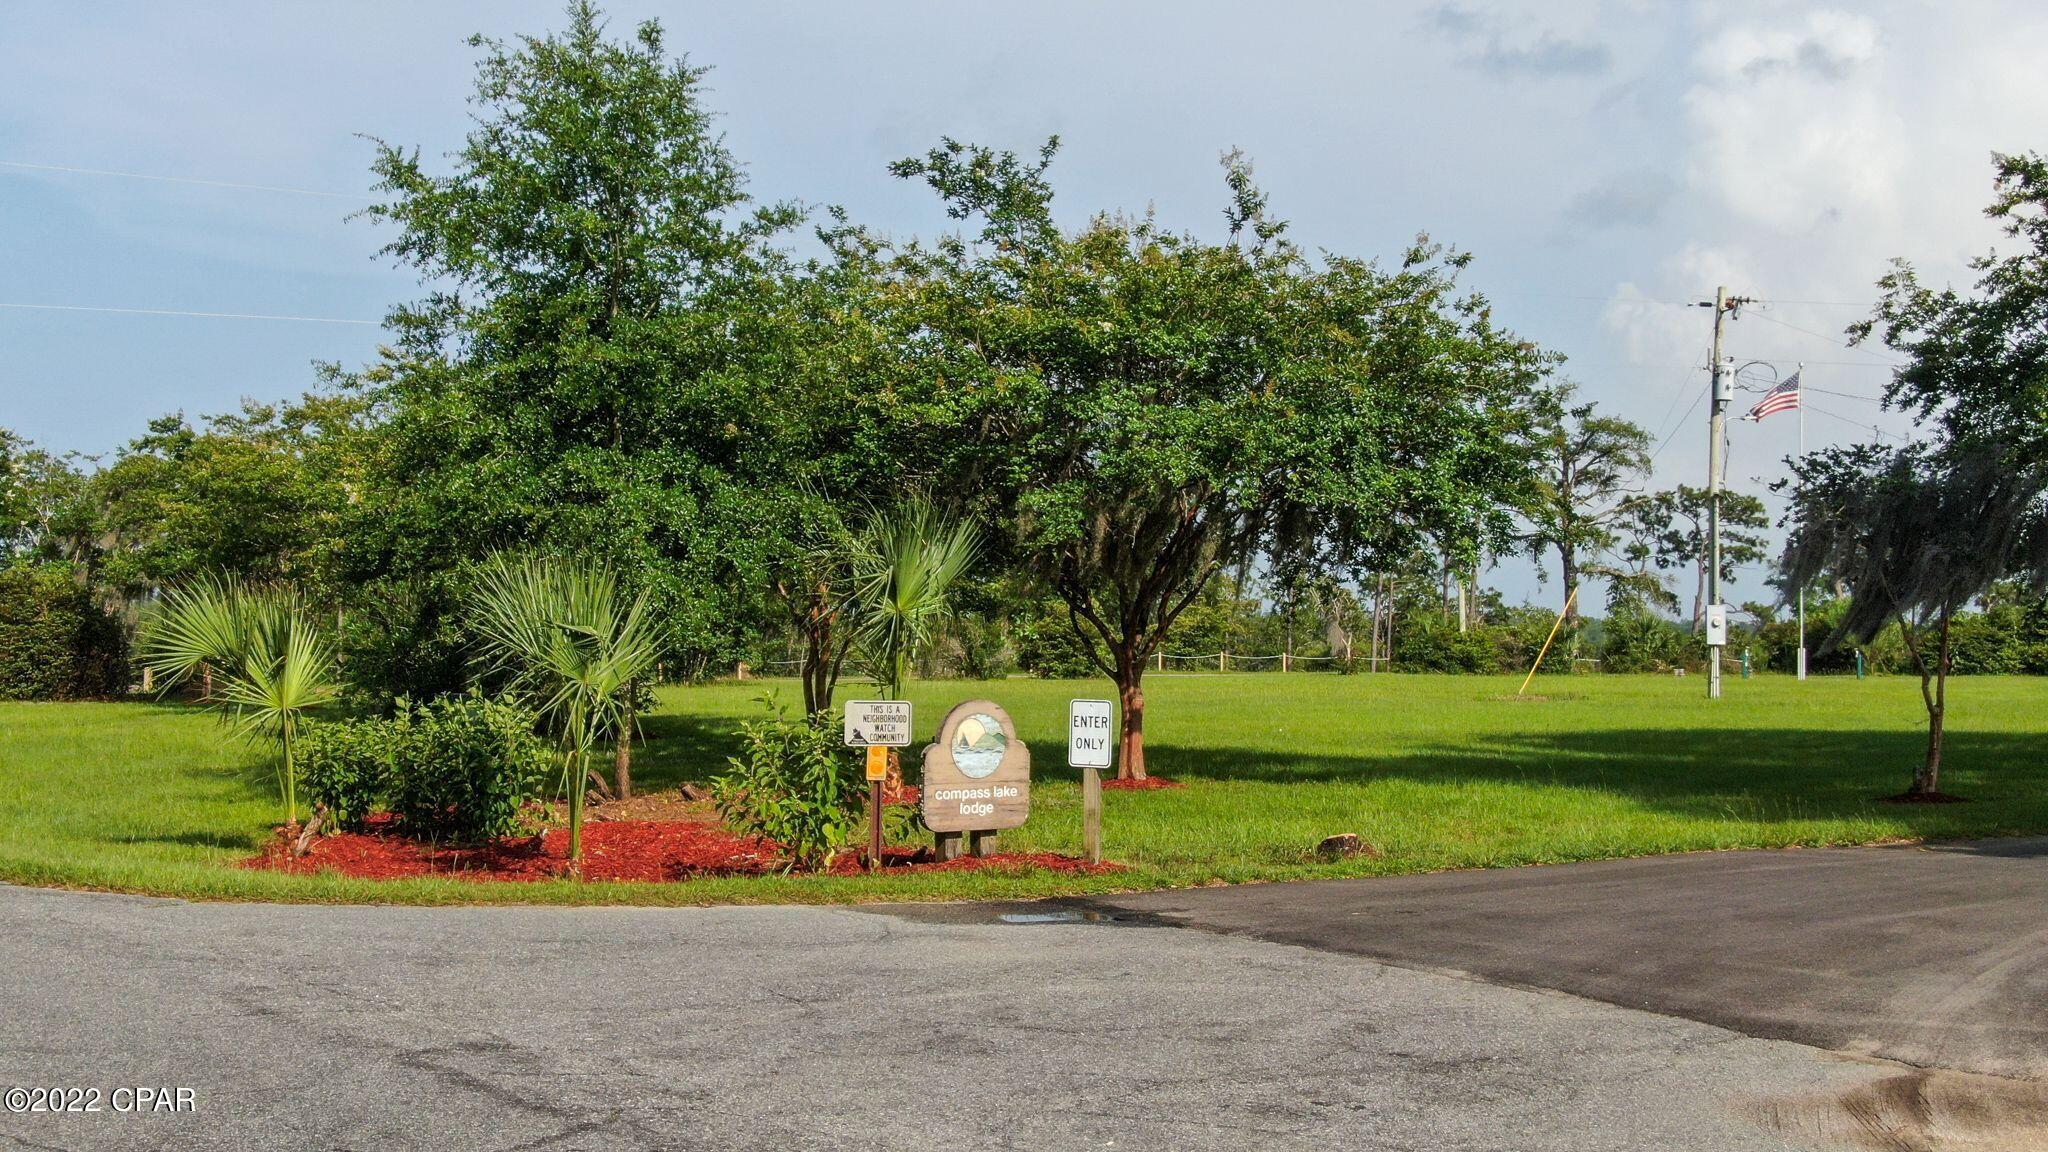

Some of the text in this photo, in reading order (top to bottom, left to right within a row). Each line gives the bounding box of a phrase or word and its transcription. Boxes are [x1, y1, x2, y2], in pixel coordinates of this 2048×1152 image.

[870, 705, 901, 714] THIS IS A
[863, 715, 907, 723] NEIGHBORHOOD
[1074, 716, 1108, 729] ENTER
[874, 724, 896, 732] WATCH
[870, 734, 904, 742] COMMUNITY
[1076, 738, 1104, 750] ONLY
[935, 785, 1018, 801] compass lake
[959, 802, 994, 816] lodge
